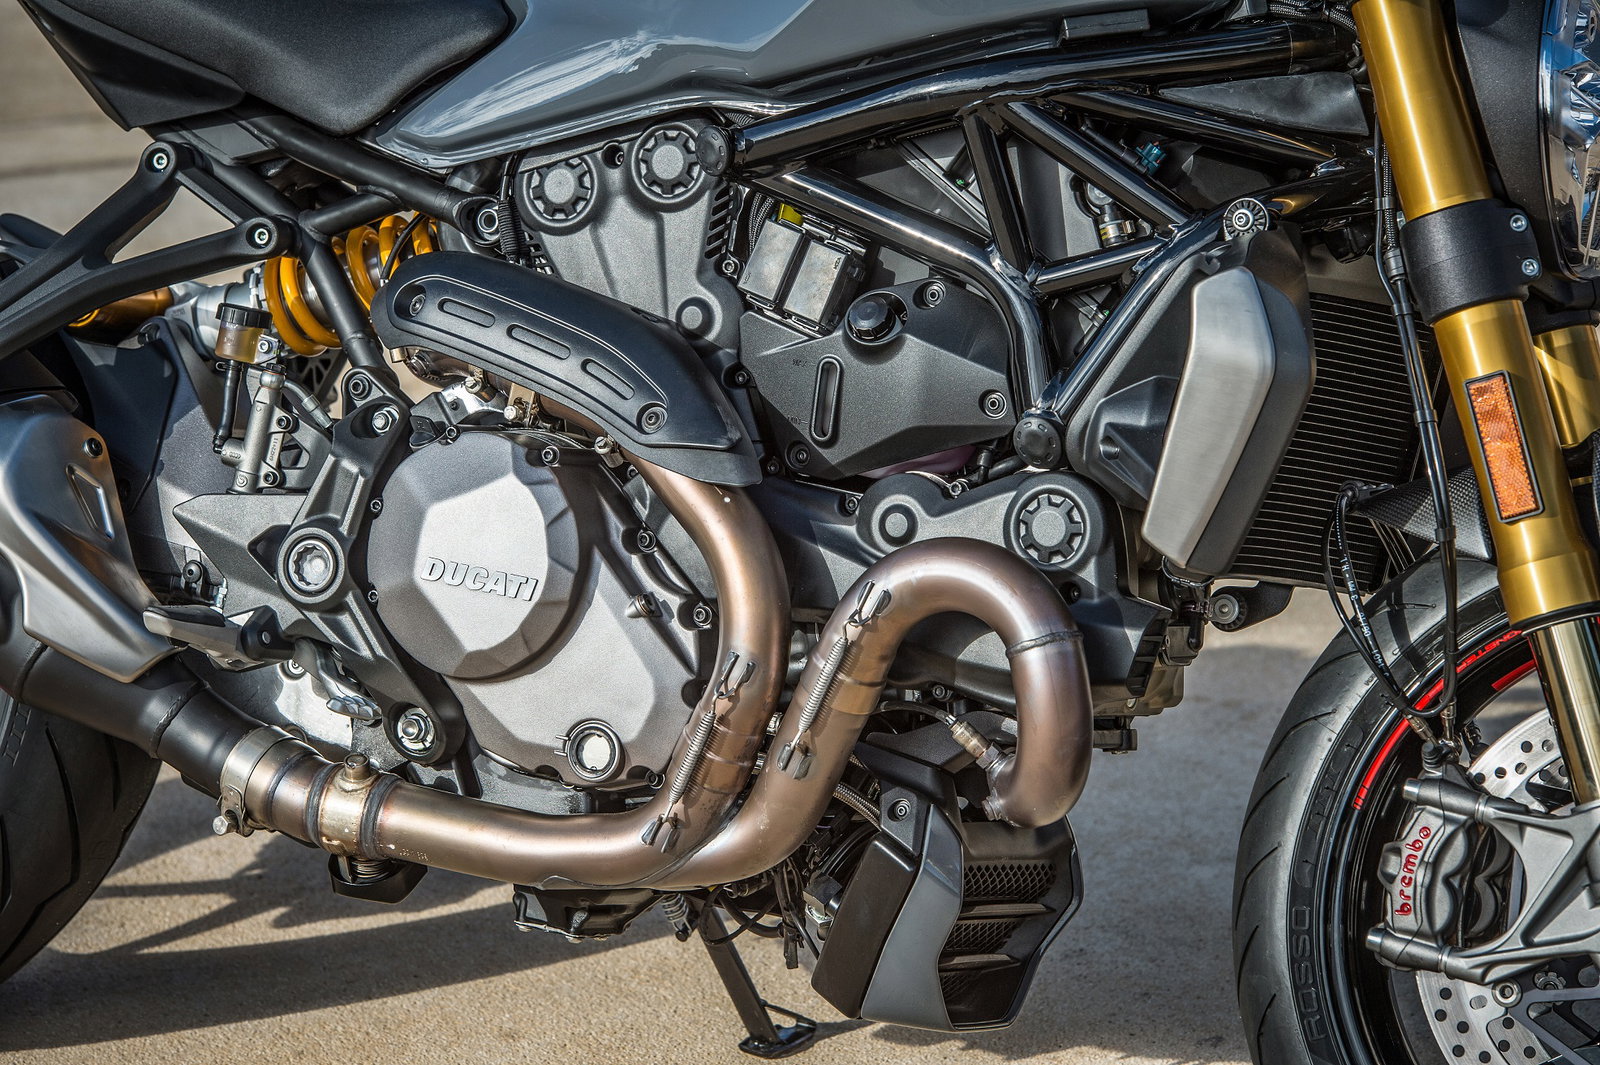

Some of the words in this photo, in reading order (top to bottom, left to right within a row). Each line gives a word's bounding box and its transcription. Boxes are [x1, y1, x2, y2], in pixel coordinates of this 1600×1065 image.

[420, 556, 539, 601] DUCATI
[1394, 826, 1432, 916] brembo
[1291, 905, 1327, 1041] ROSSO
